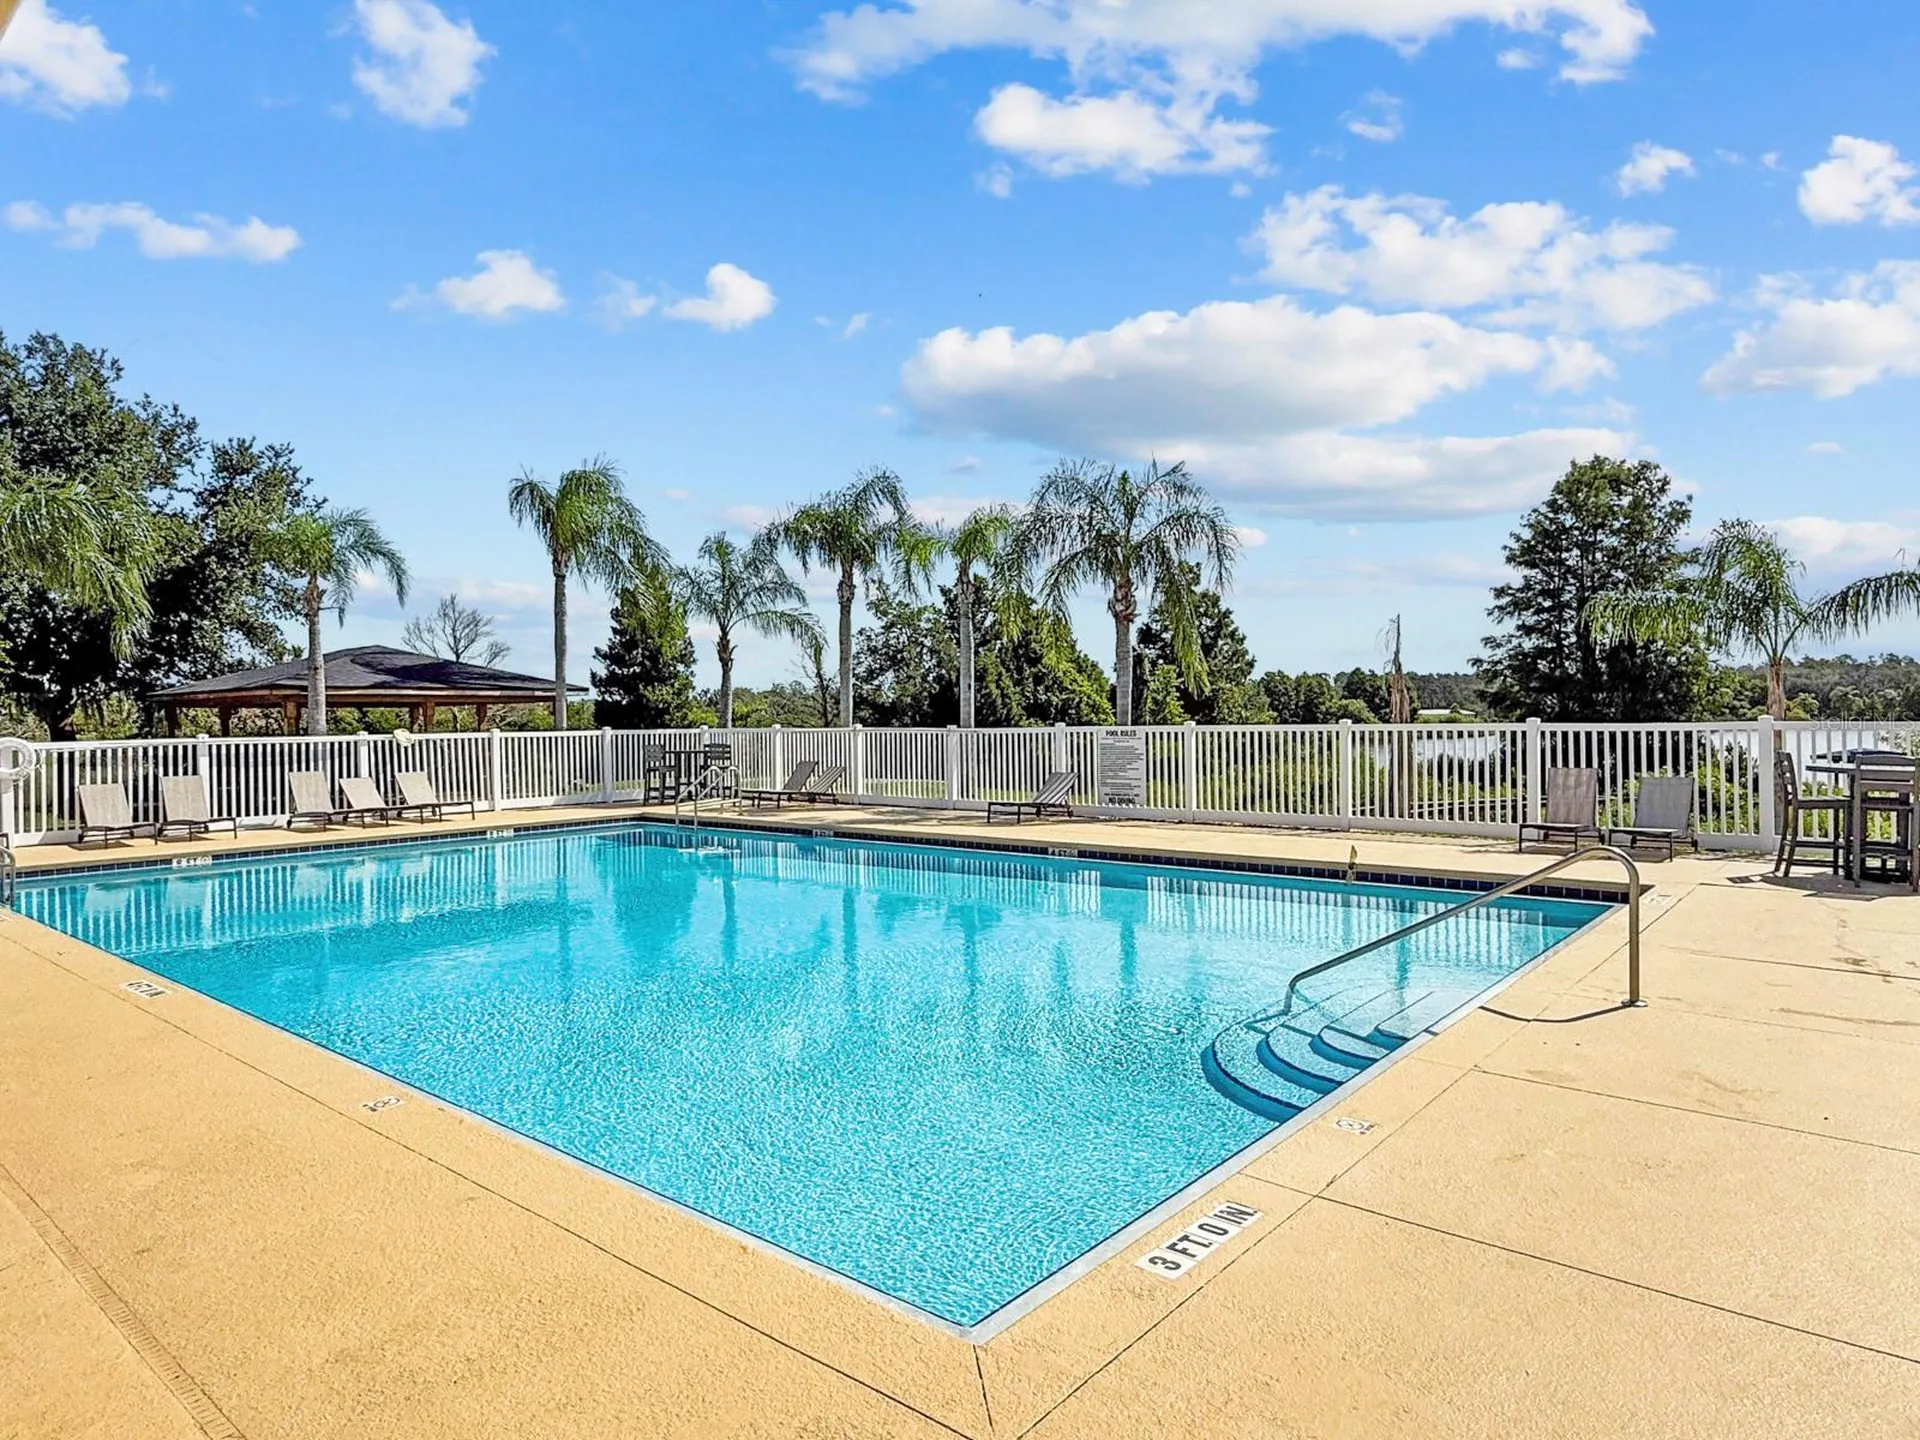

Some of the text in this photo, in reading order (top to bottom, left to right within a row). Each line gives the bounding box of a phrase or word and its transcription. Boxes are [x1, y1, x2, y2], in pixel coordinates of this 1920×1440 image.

[1148, 1255, 1182, 1271] 3
[1165, 1234, 1214, 1258] FT.
[1213, 1205, 1258, 1225] IN.
